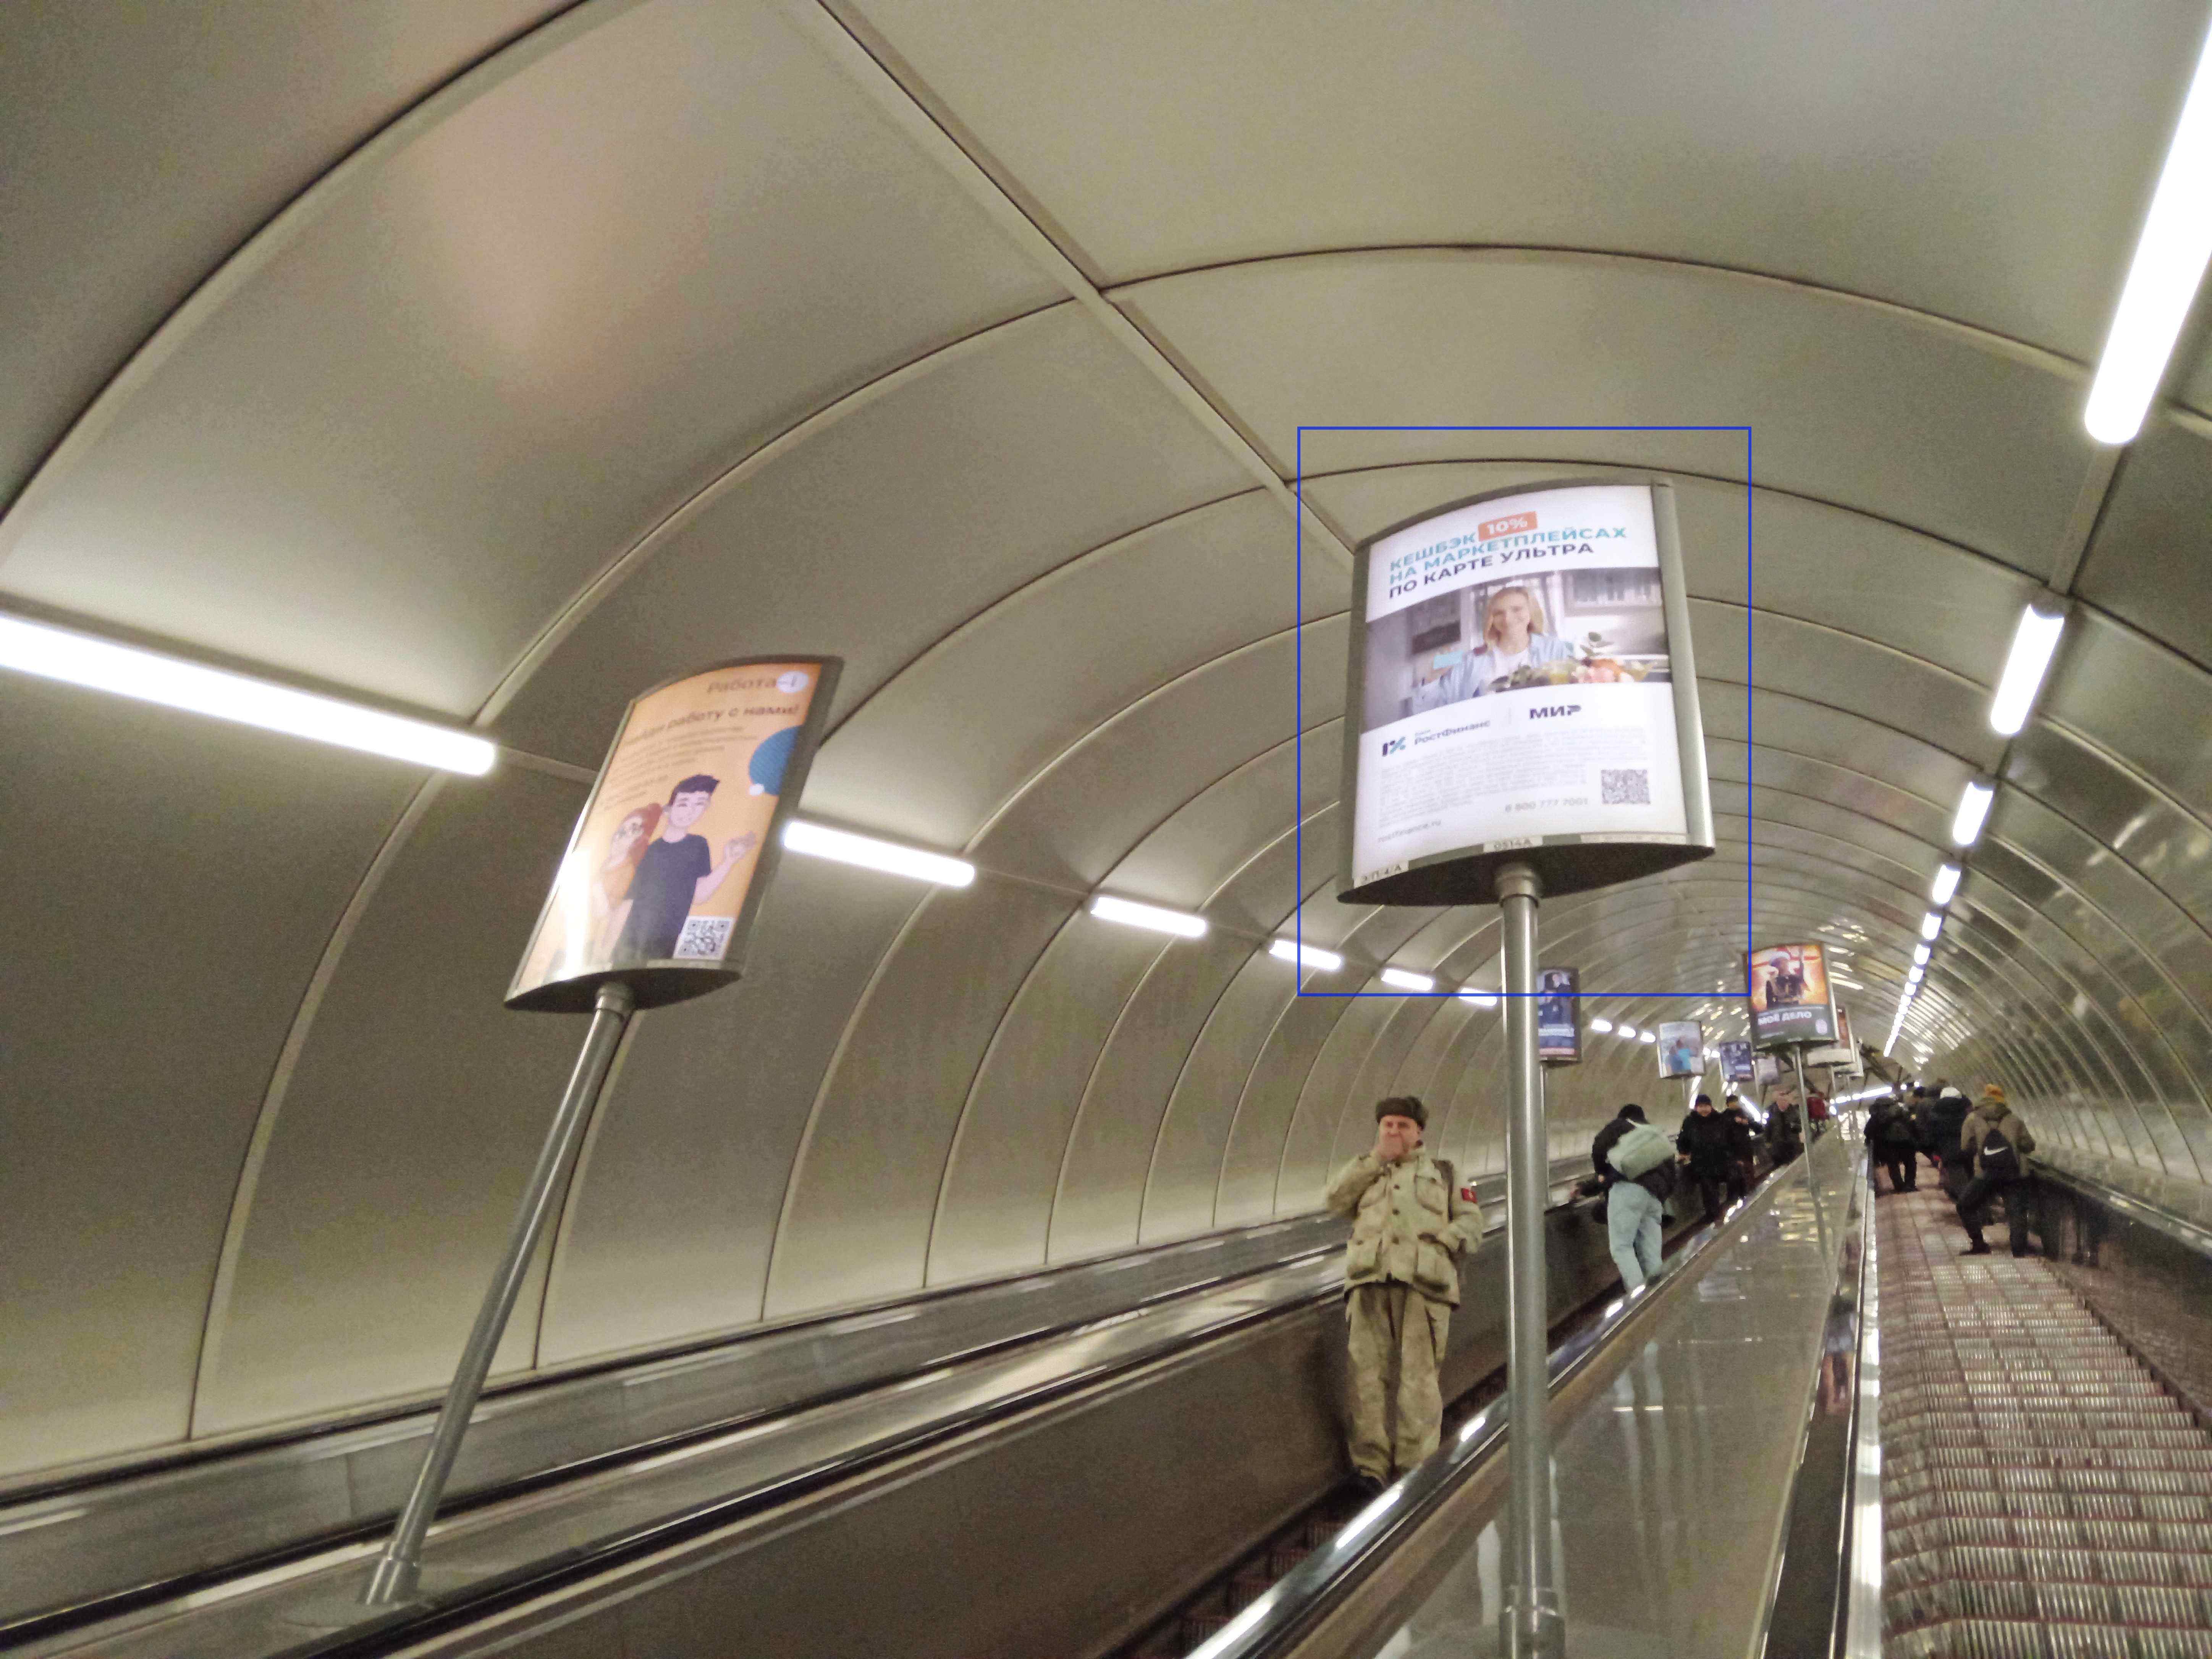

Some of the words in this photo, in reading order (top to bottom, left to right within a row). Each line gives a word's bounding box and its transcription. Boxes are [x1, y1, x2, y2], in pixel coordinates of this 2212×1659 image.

[1389, 568, 1418, 585] НА
[1424, 526, 1627, 572] МАРКЕТПЛЕЙСАХ
[1389, 580, 1418, 599] ПО
[1424, 556, 1493, 585] КАРТЕ
[1501, 543, 1594, 564] УЛЬТРА
[1390, 532, 1477, 572] КЕШБЭК
[1487, 517, 1528, 535] 10%
[1414, 720, 1491, 745] РостФинанс
[1529, 705, 1582, 720] МИР
